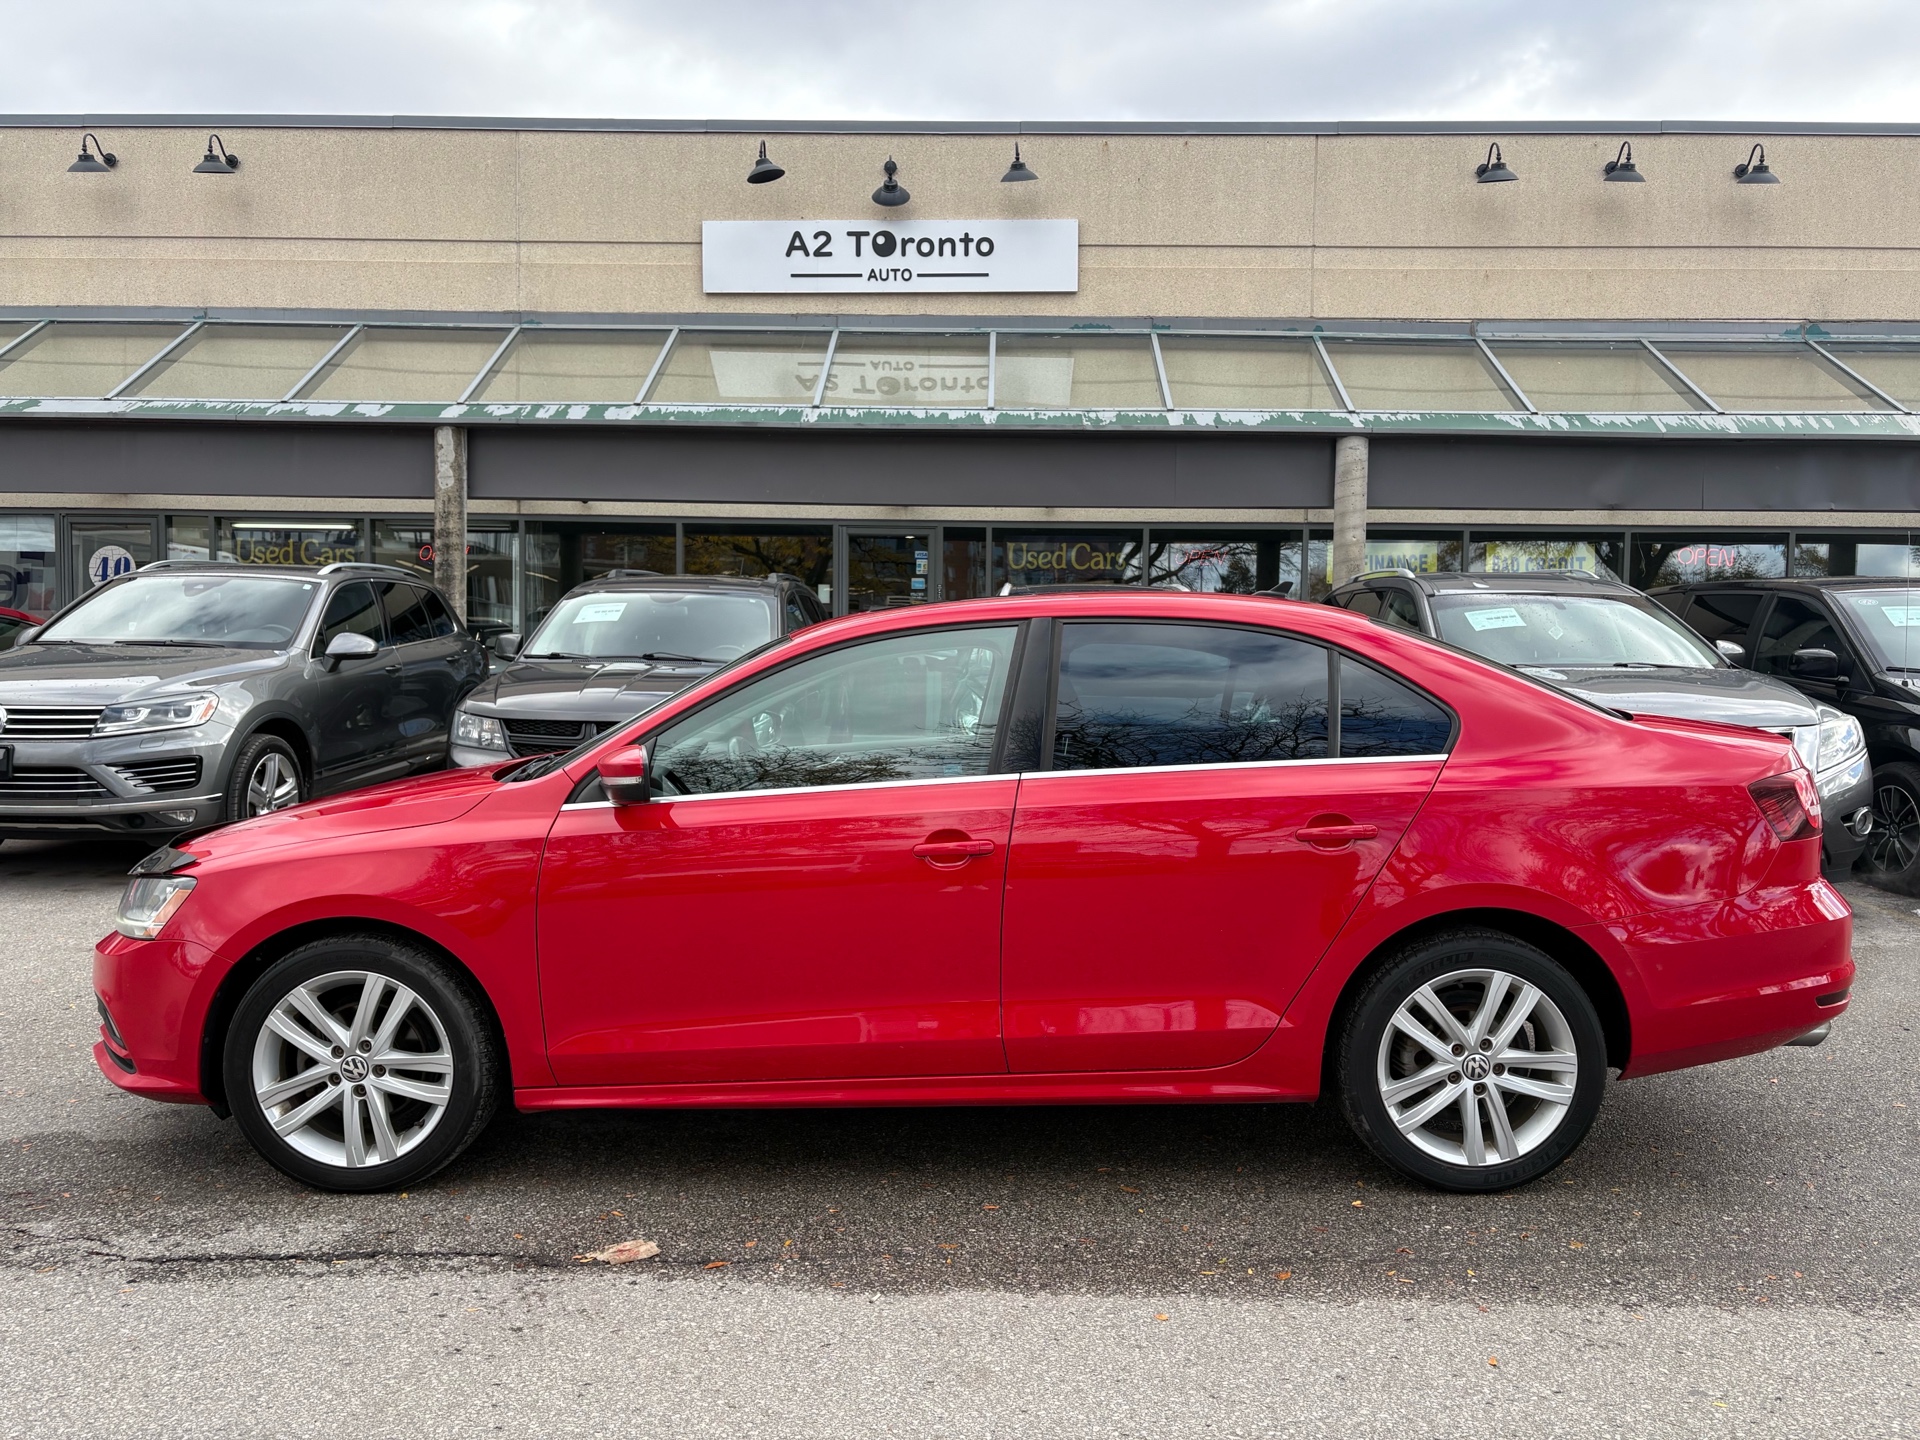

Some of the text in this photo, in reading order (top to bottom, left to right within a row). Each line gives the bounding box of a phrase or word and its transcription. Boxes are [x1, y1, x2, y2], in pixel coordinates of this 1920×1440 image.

[785, 230, 833, 258] A2
[867, 268, 912, 282] AUTO
[235, 537, 356, 565] Used Cars
[1006, 541, 1127, 571] Used Cars
[1174, 549, 1229, 566] OPEN
[1677, 546, 1735, 567] OPEN
[1491, 554, 1520, 573] BAD
[1397, 951, 1474, 992] MICHELIN
